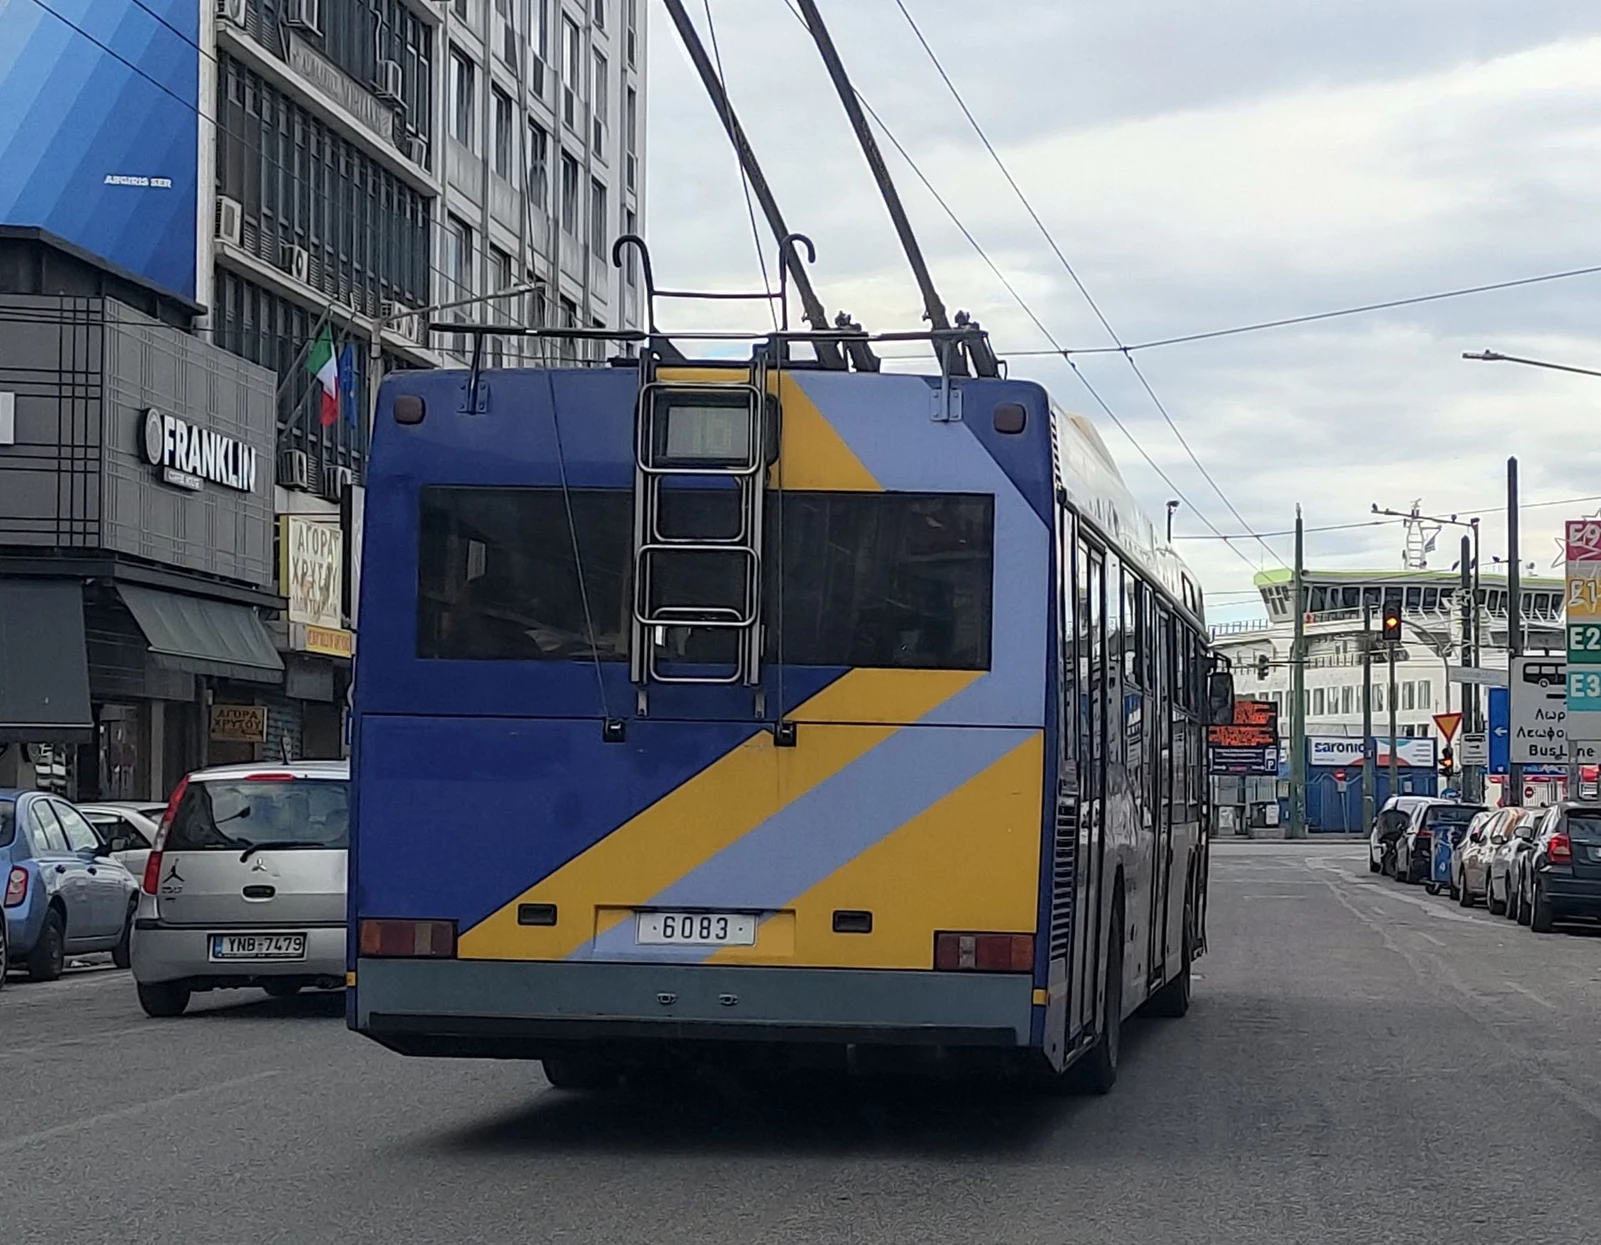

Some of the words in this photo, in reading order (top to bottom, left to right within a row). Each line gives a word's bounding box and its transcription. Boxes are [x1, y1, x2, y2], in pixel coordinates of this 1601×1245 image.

[163, 414, 256, 493] FRANKLIN
[1569, 523, 1600, 547] E9
[1570, 580, 1597, 605] E1
[1570, 626, 1600, 650] E2
[1570, 673, 1600, 697] E3
[216, 709, 258, 720] ΑΓΟΡΑ
[1535, 708, 1566, 723] Λωρ
[1516, 726, 1565, 741] Λεωφο
[662, 916, 729, 940] 6083
[228, 937, 303, 953] YNB-7479
